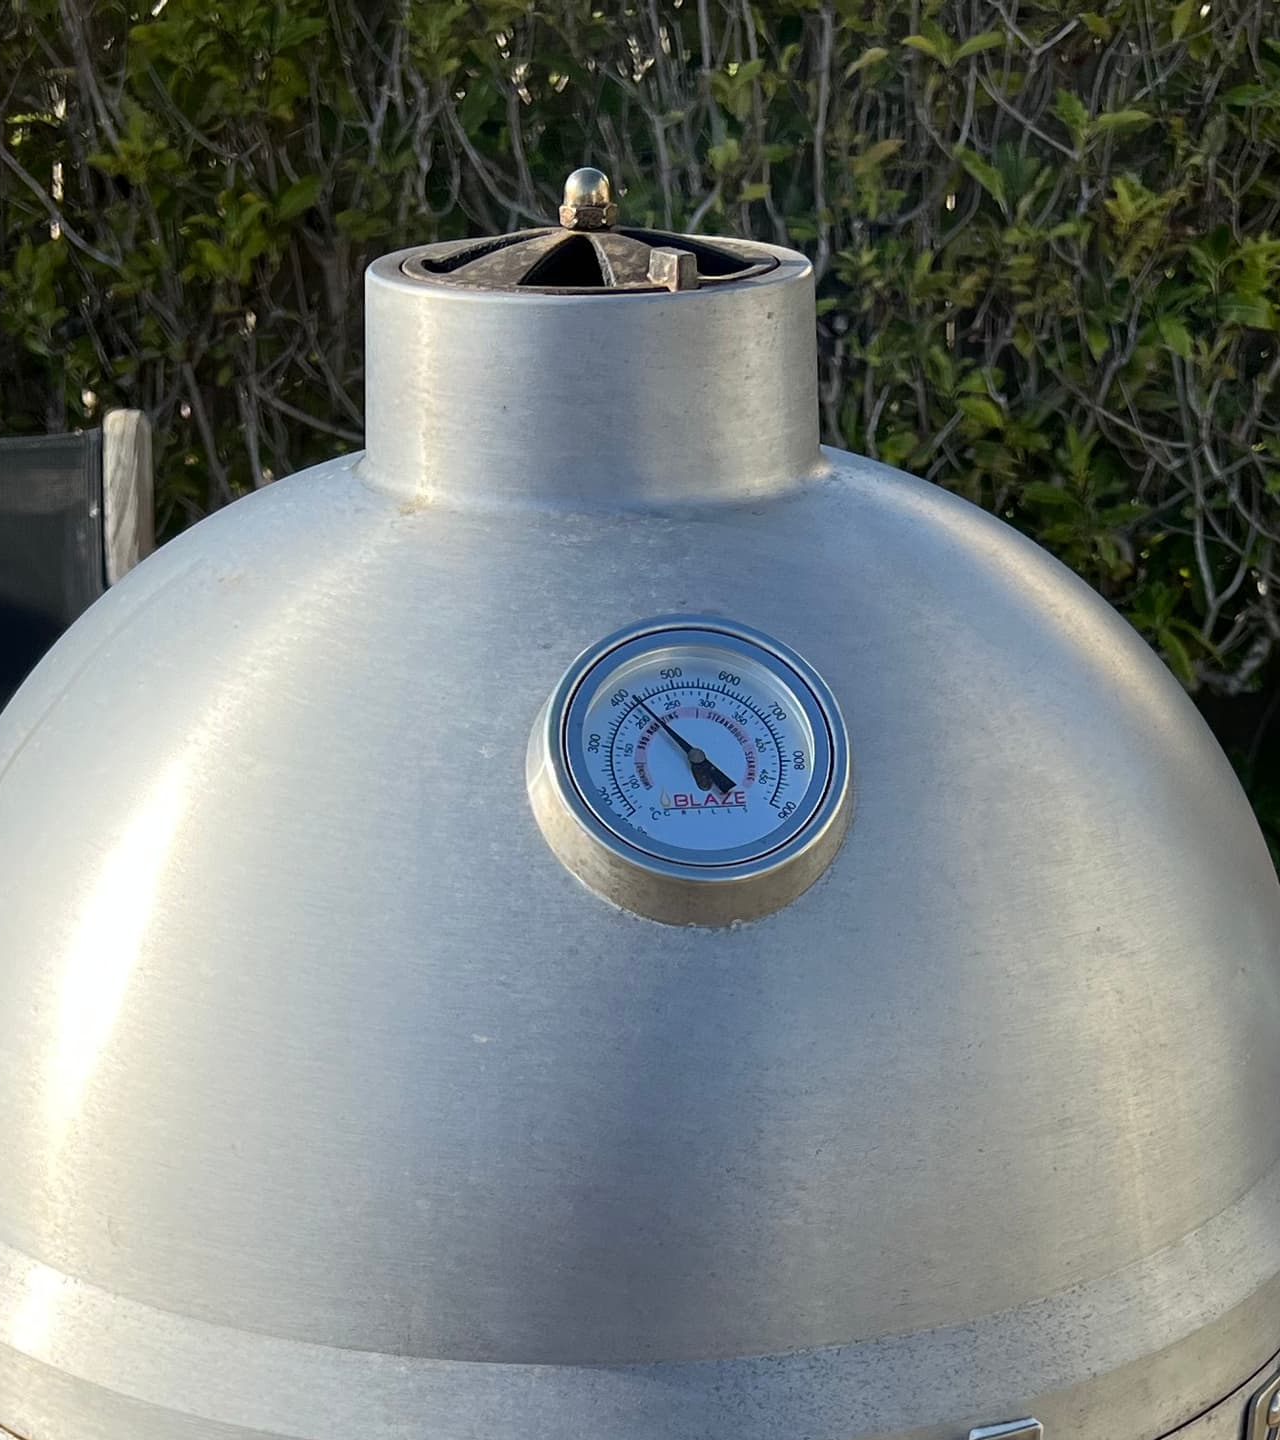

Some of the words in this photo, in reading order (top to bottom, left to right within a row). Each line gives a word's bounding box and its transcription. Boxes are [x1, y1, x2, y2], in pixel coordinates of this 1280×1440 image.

[660, 667, 682, 680] 500
[718, 671, 741, 686] 600
[610, 689, 629, 707] 400
[664, 700, 681, 711] 250
[698, 699, 716, 709] 300
[731, 711, 748, 726] 350
[767, 701, 787, 721] 700
[635, 714, 651, 730] 200
[587, 734, 601, 754] 300
[624, 743, 634, 757] 150
[755, 738, 767, 753] 400
[793, 750, 805, 770] 800
[628, 774, 641, 790] 100
[759, 769, 769, 785] 450
[673, 791, 747, 808] BLAZE
[777, 801, 797, 819] 900
